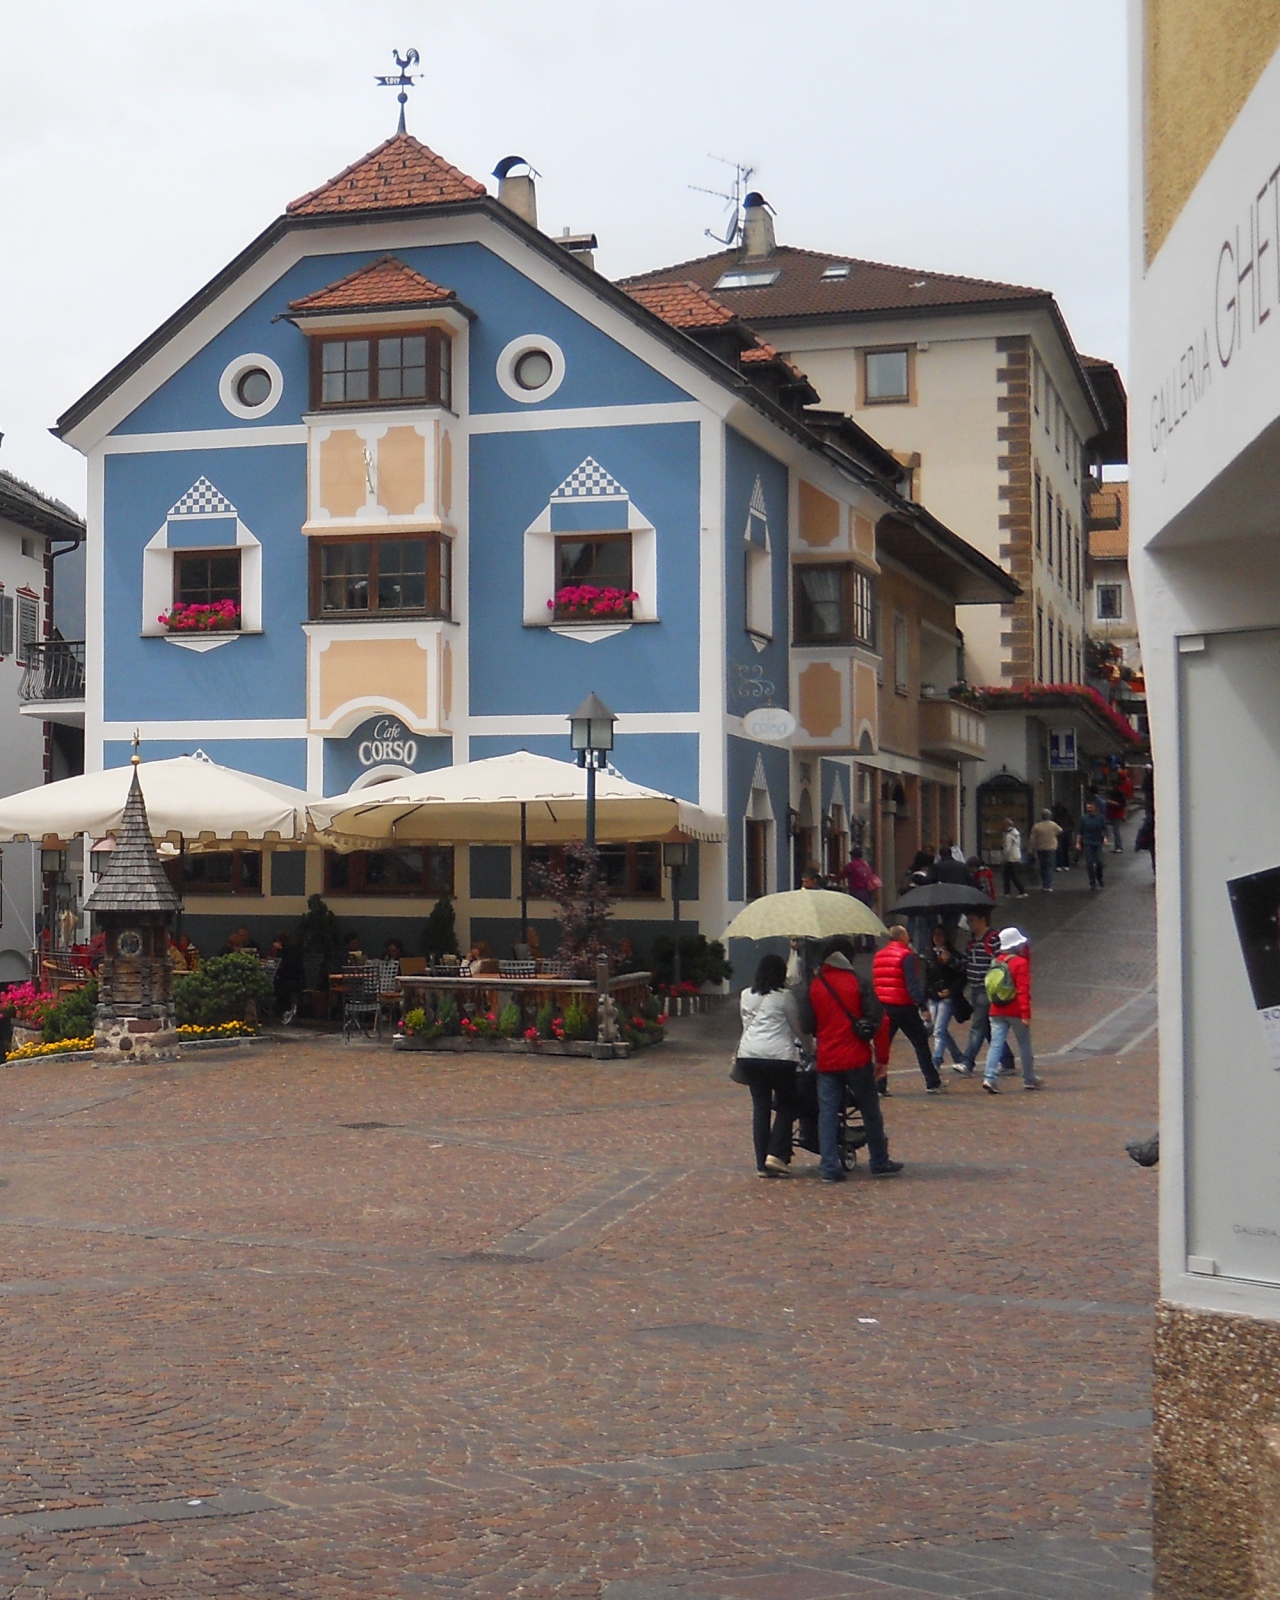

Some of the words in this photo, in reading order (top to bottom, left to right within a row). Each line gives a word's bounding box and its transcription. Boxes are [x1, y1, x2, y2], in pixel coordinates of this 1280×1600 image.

[1151, 327, 1212, 453] GALLERIA
[374, 719, 401, 741] Cafe
[358, 740, 418, 766] CORSO
